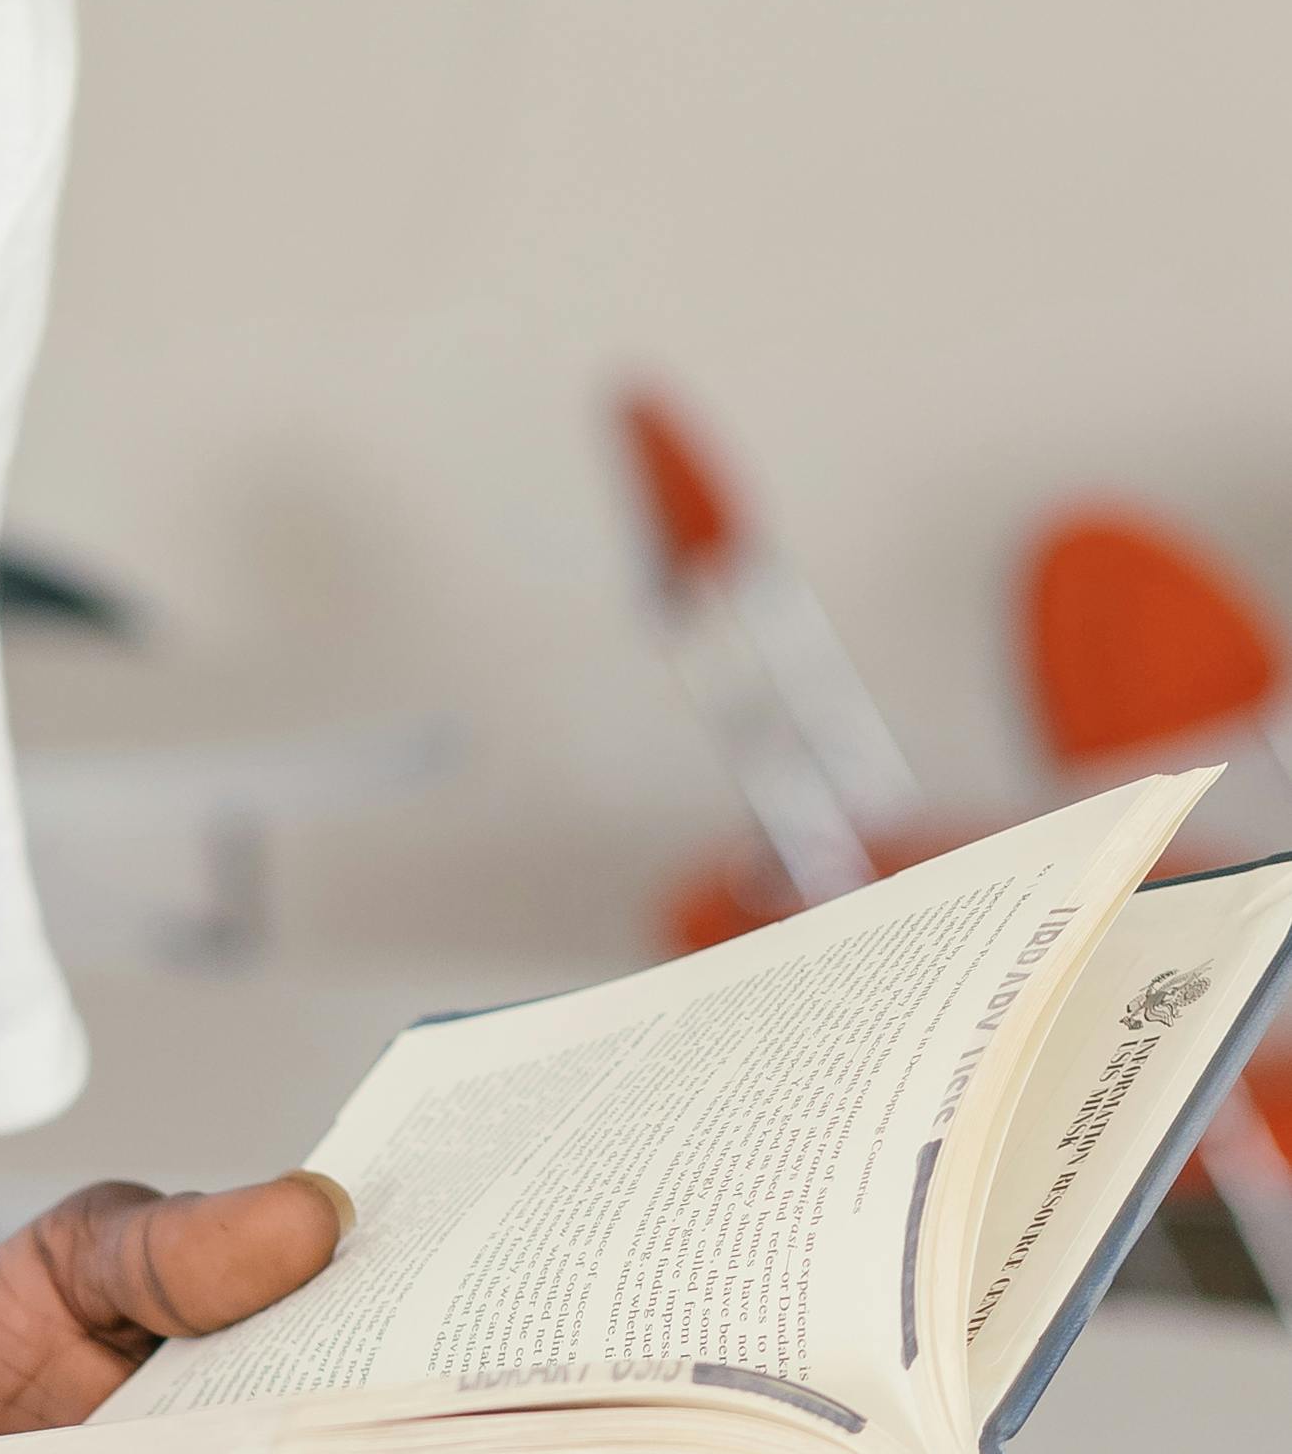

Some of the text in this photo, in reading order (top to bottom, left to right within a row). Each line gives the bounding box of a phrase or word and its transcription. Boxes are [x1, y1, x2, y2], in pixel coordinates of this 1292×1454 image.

[852, 948, 988, 1213] Policymaking in Developing Countries
[1057, 1040, 1137, 1152] USIS MINSK
[1065, 1034, 1162, 1167] INFORMATION
[738, 1128, 772, 1177] know,
[768, 1113, 793, 1150] good
[788, 1126, 817, 1180] always
[821, 1120, 840, 1139] the
[704, 1153, 741, 1225] problems,
[731, 1181, 744, 1197] of
[758, 1153, 773, 1171] as
[764, 1128, 800, 1200] promised
[822, 1164, 835, 1181] of
[634, 1138, 706, 1290] was worth doing, or
[743, 1173, 765, 1208] they
[775, 1189, 794, 1221] find
[809, 1186, 827, 1225] such
[569, 1148, 657, 1346] overall balance of success
[605, 1133, 695, 1341] of administrative structure,
[643, 1122, 728, 1318] unacceptable, but finding
[712, 1202, 736, 1257] course,
[727, 1213, 750, 1269] should
[746, 1210, 771, 1267] homes
[804, 1231, 816, 1252] an
[999, 1170, 1078, 1273] RESOURCE
[660, 1140, 733, 1358] strongly negative impress
[686, 1239, 706, 1291] culled
[518, 1244, 559, 1339] whether the
[532, 1223, 586, 1355] the resettled net
[547, 1199, 612, 1361] means of concluding
[704, 1269, 719, 1299] that
[720, 1274, 737, 1317] have
[738, 1278, 755, 1321] have
[758, 1231, 779, 1323] references
[441, 1294, 464, 1326] best
[460, 1275, 501, 1372] the question
[484, 1284, 511, 1340] we can
[496, 1271, 530, 1367] endowment
[680, 1300, 696, 1344] from
[698, 1307, 710, 1356] some
[796, 1258, 810, 1358] experience
[713, 1322, 731, 1368] been
[737, 1334, 748, 1363] not
[756, 1334, 767, 1353] to
[798, 1365, 811, 1381] is
